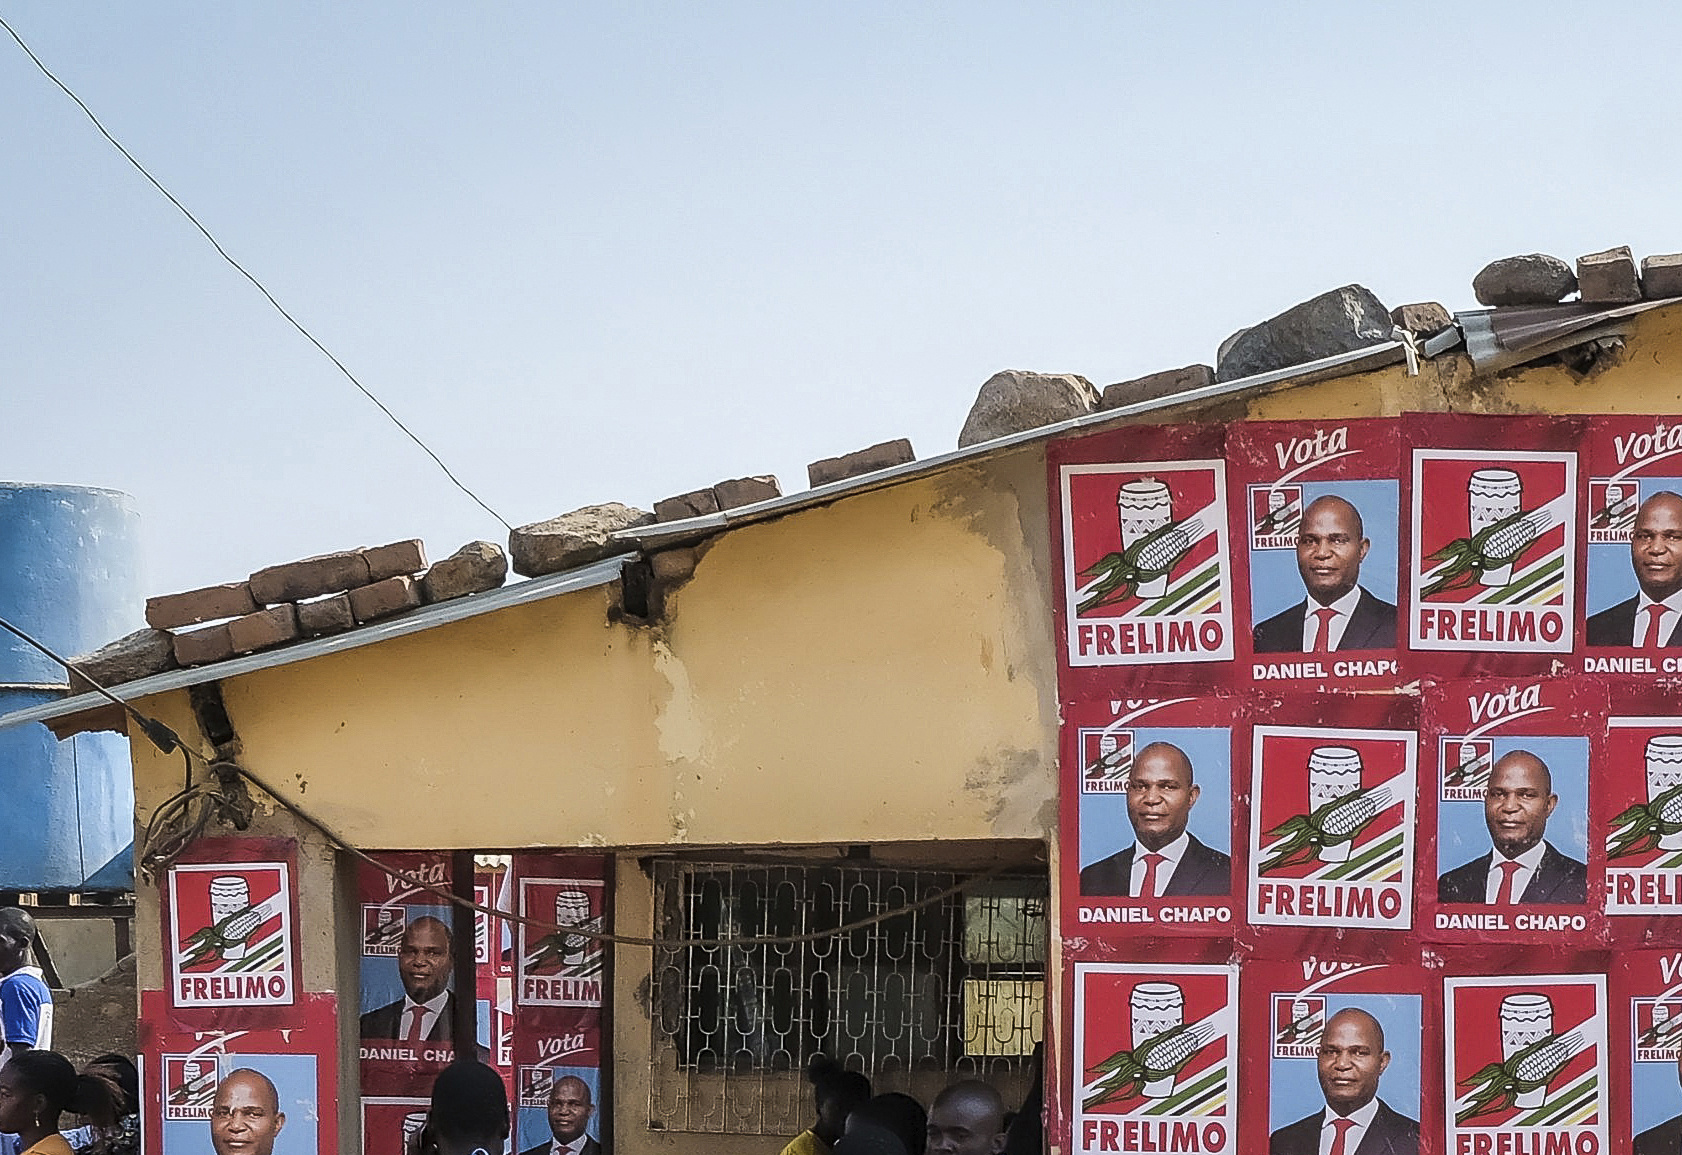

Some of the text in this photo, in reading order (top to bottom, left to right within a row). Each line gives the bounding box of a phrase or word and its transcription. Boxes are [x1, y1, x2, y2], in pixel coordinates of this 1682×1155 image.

[1275, 424, 1349, 469] Vota
[1420, 609, 1563, 642] FRELIMO
[1078, 620, 1223, 656] FRELIMO
[1253, 663, 1327, 679] DANIEL
[1585, 658, 1656, 672] DANIEL
[1469, 685, 1540, 723] Vota
[1258, 884, 1401, 919] FRELIMO
[1079, 908, 1230, 922] DANIEL CHAPO
[1436, 914, 1585, 930] DANIEL CHAPO
[181, 976, 285, 1000] FRELIMO
[524, 980, 600, 1002] FRELIM
[424, 1050, 454, 1062] CHA
[538, 1034, 584, 1057] Vota
[1083, 1120, 1226, 1153] FRELIMO
